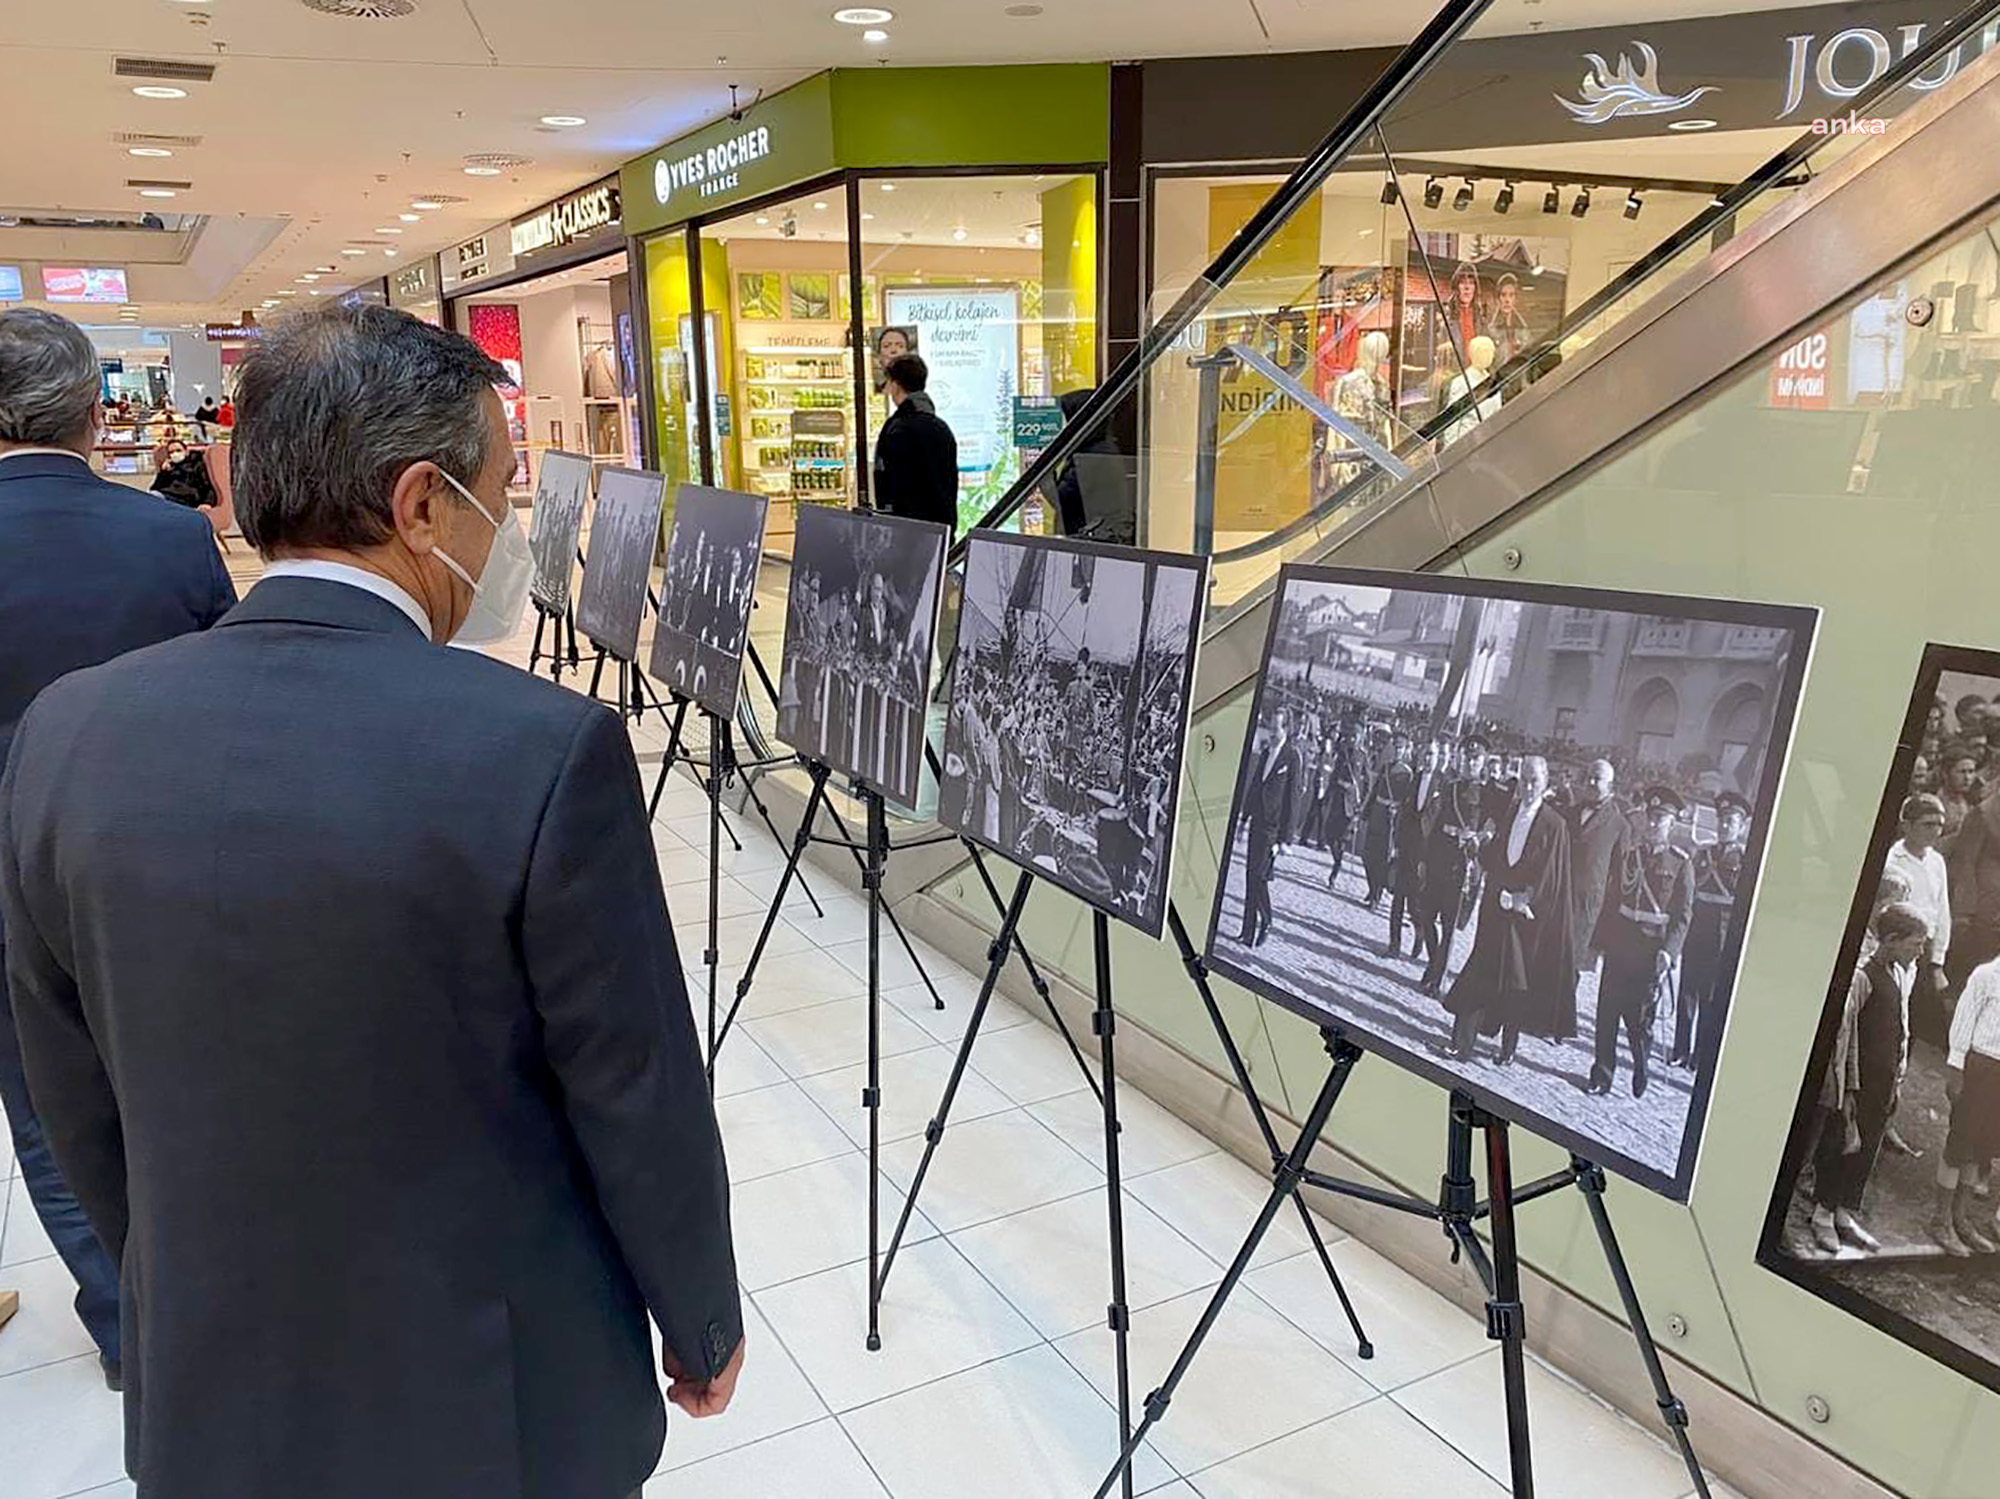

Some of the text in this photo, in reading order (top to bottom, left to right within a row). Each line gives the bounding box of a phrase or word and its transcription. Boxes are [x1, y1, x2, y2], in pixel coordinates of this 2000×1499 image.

[1774, 20, 2000, 120] JOU
[670, 126, 769, 190] YVES ROCHER
[700, 172, 738, 197] FRANCE
[562, 187, 610, 235] CLASSICS
[1220, 387, 1306, 413] NDİRİM
[1016, 423, 1041, 436] 229
